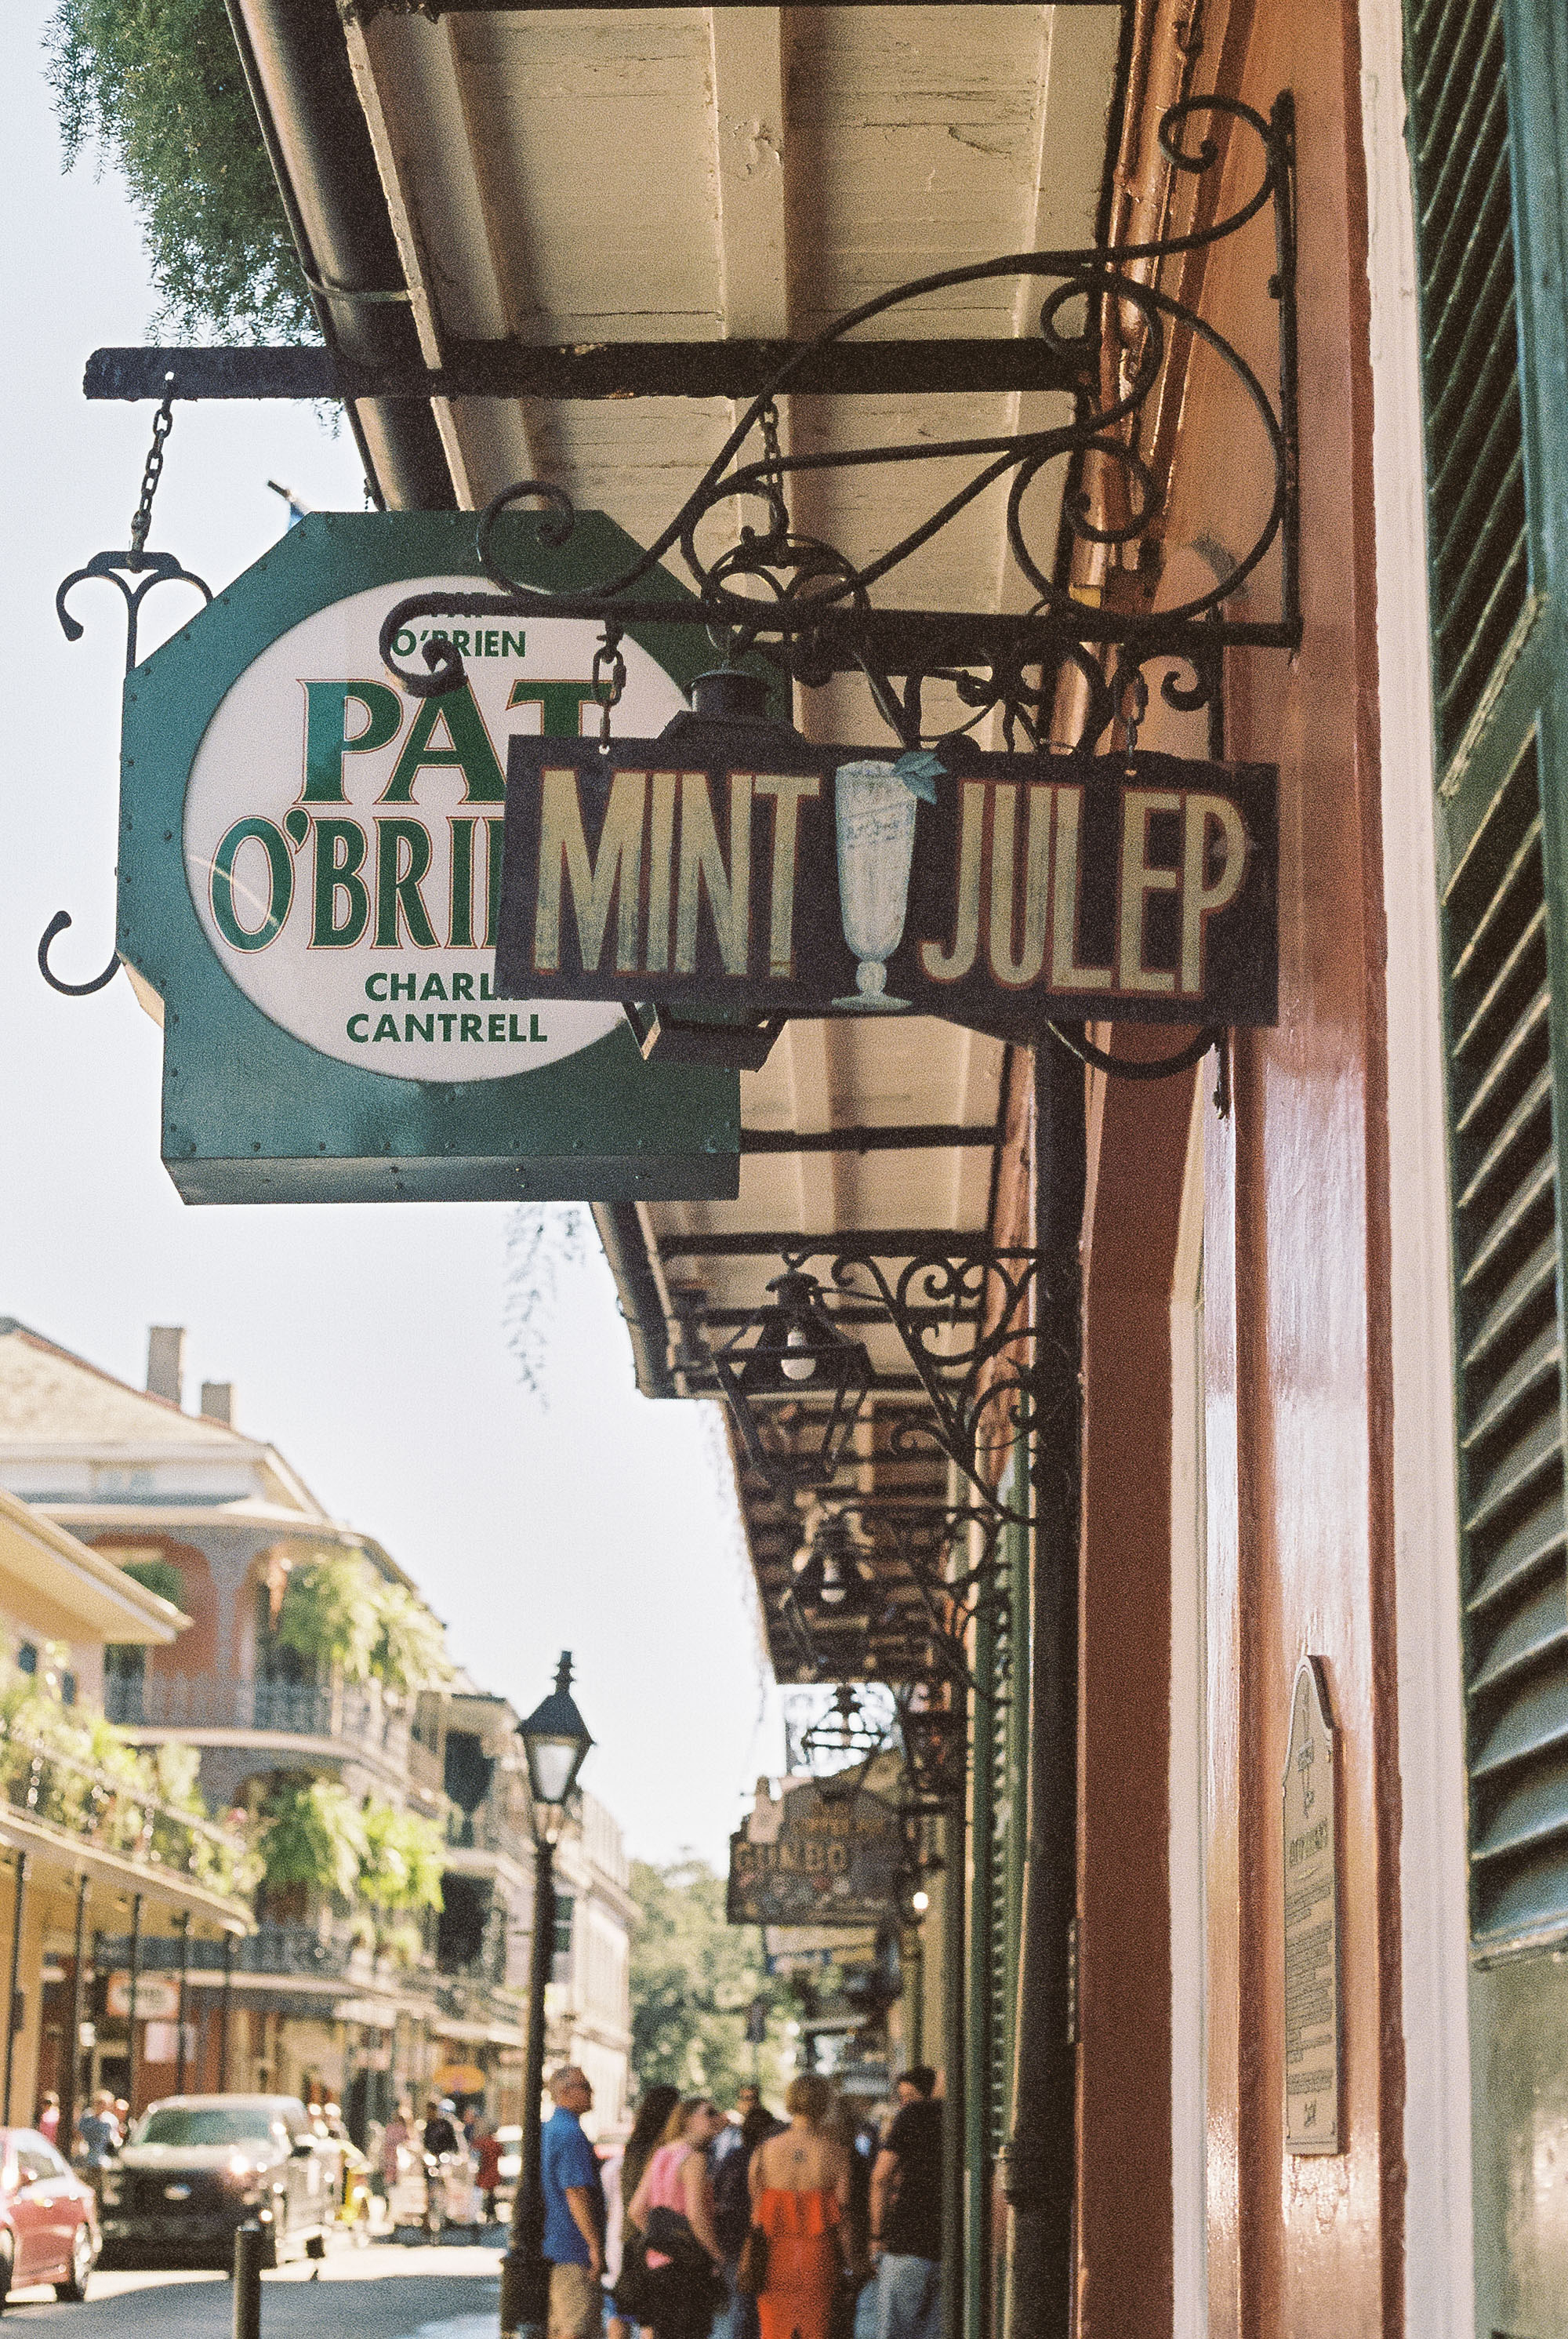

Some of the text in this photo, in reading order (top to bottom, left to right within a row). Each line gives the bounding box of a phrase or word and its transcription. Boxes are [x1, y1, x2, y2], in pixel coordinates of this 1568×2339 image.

[534, 766, 1250, 997] MINT JULEP
[365, 972, 530, 1001] CHARL
[346, 1013, 548, 1043] CANTRELL
